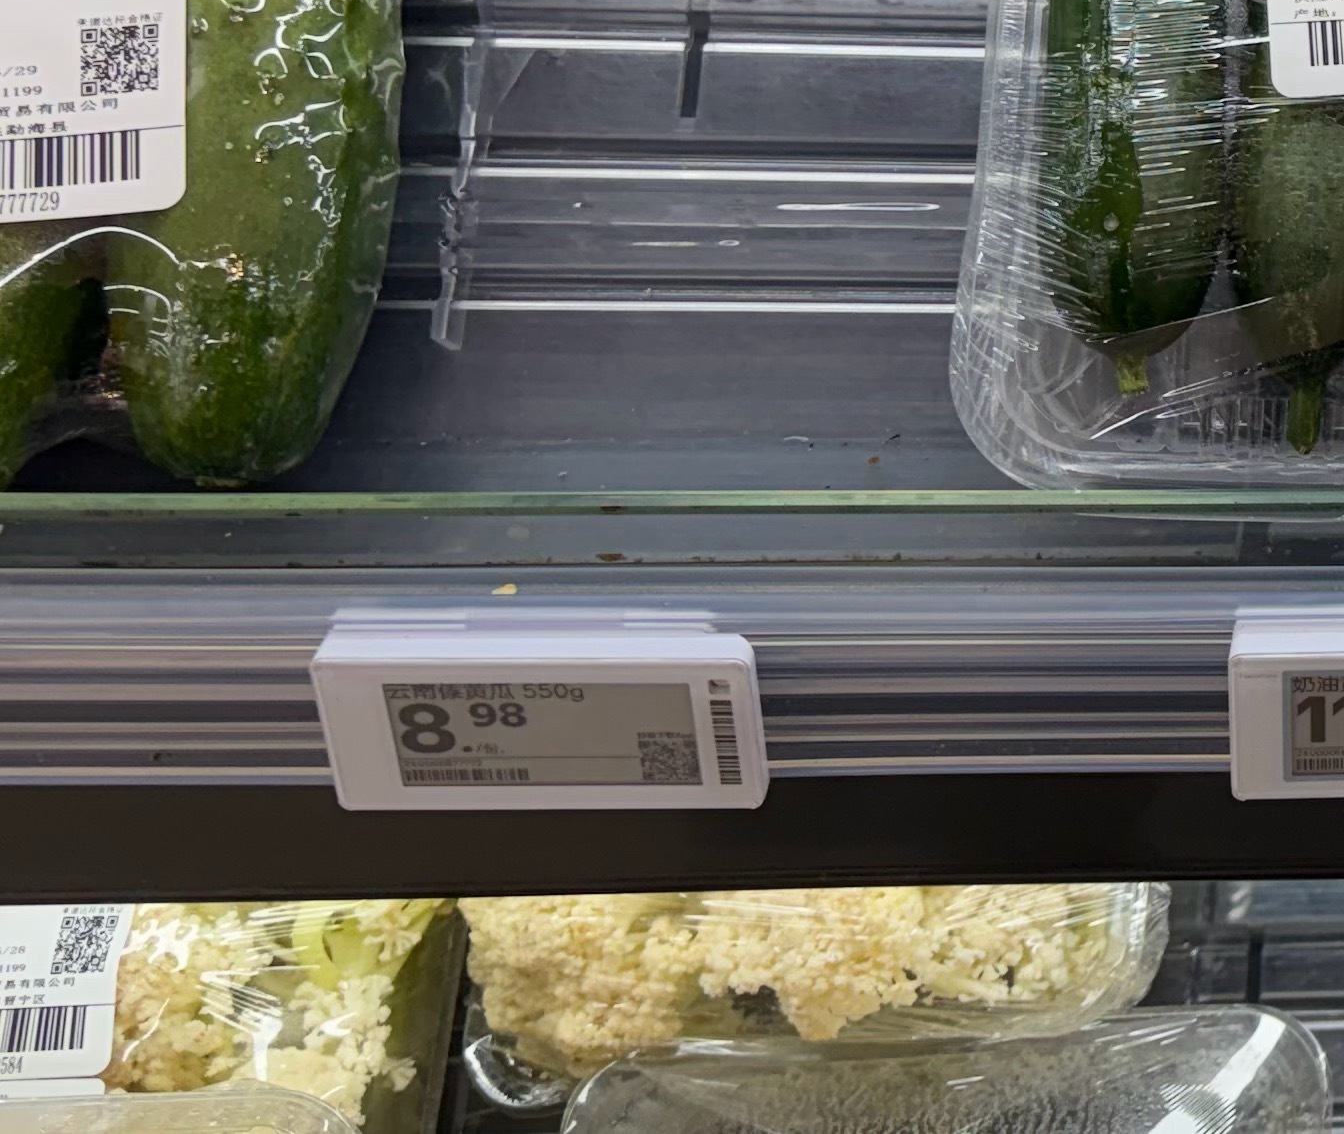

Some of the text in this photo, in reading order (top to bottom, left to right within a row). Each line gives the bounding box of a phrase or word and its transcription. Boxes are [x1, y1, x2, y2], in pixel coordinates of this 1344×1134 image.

[0, 65, 38, 78] /29
[522, 682, 585, 702] 550g
[0, 977, 76, 990] 易有限公司
[0, 1056, 24, 1074] 584
